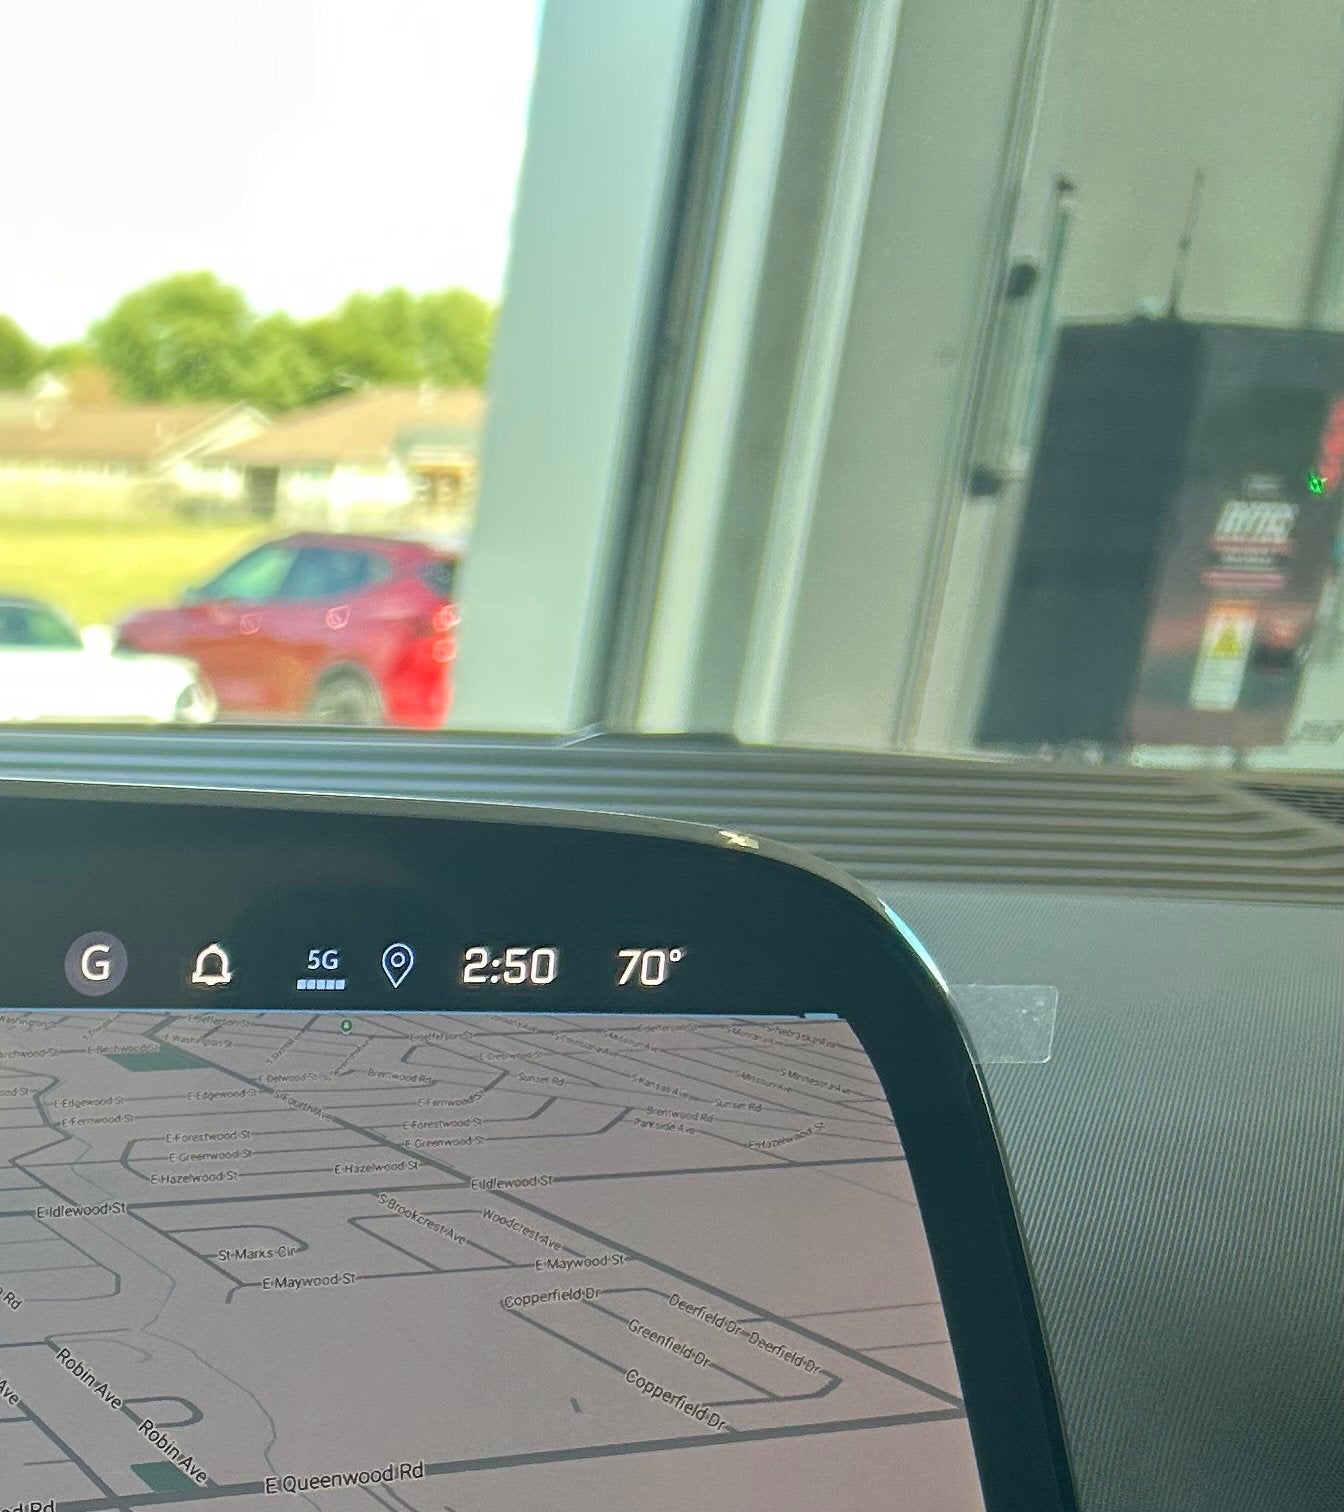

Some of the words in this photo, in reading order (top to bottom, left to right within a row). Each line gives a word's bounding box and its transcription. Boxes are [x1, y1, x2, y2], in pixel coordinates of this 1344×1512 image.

[81, 944, 111, 982] G
[307, 949, 340, 971] 5G
[462, 946, 558, 985] 2:50
[36, 1207, 44, 1218] E
[48, 1205, 108, 1218] Idlewood
[112, 1202, 126, 1213] St
[378, 1193, 387, 1204] S
[387, 1198, 448, 1233] Brookcrest
[446, 1226, 466, 1245] Ave
[482, 1208, 540, 1241] Woodcrest
[538, 1231, 561, 1251] Ave
[218, 1249, 231, 1261] St
[235, 1249, 274, 1260] Marks
[277, 1246, 296, 1258] Cir
[535, 1260, 543, 1271] E
[547, 1254, 607, 1271] Maywood
[611, 1253, 625, 1265] St
[2, 1291, 22, 1310] Rd
[262, 1278, 271, 1290] E
[274, 1274, 339, 1291] Maywood
[342, 1273, 356, 1285] St
[504, 1288, 581, 1309] Copperfield
[585, 1287, 601, 1299] Dr
[668, 1293, 725, 1329] Deerfield
[724, 1320, 742, 1336] Dr
[628, 1318, 693, 1359] Greenfield
[693, 1352, 711, 1368] Dr
[748, 1331, 804, 1367] Deerfield
[803, 1359, 821, 1374] Dr
[56, 1348, 95, 1387] Robin
[93, 1382, 122, 1410] Ave
[625, 1368, 707, 1421] Copperfield
[706, 1411, 726, 1431] Dr
[139, 1419, 178, 1460] Robin
[177, 1455, 207, 1484] Ave
[266, 1478, 277, 1494] E
[283, 1464, 395, 1492] Queenwood
[400, 1460, 425, 1480] Rd
